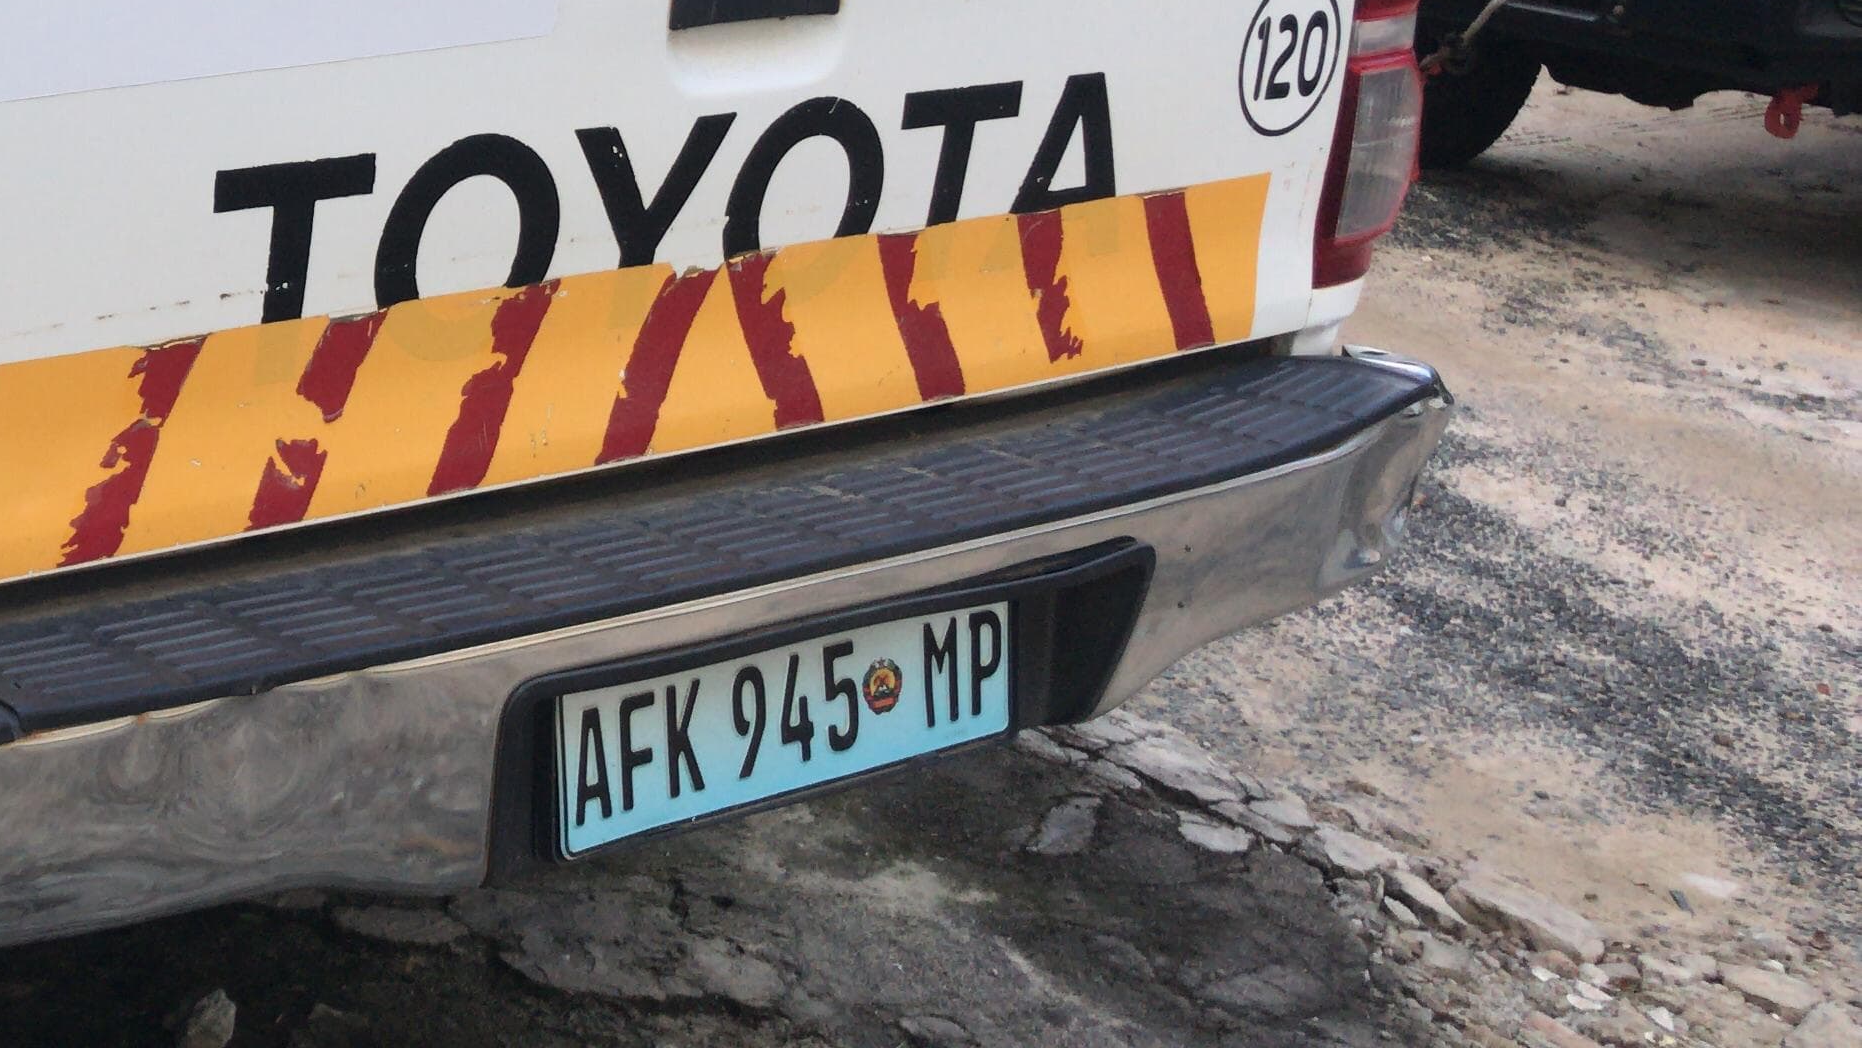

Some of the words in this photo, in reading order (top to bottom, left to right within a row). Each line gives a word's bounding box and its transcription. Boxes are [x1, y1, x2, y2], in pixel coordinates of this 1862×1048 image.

[1252, 9, 1329, 102] 120
[213, 72, 1117, 325] TOYOTA
[575, 678, 705, 827] AFK
[732, 639, 859, 780] 945
[923, 609, 1002, 728] MP
